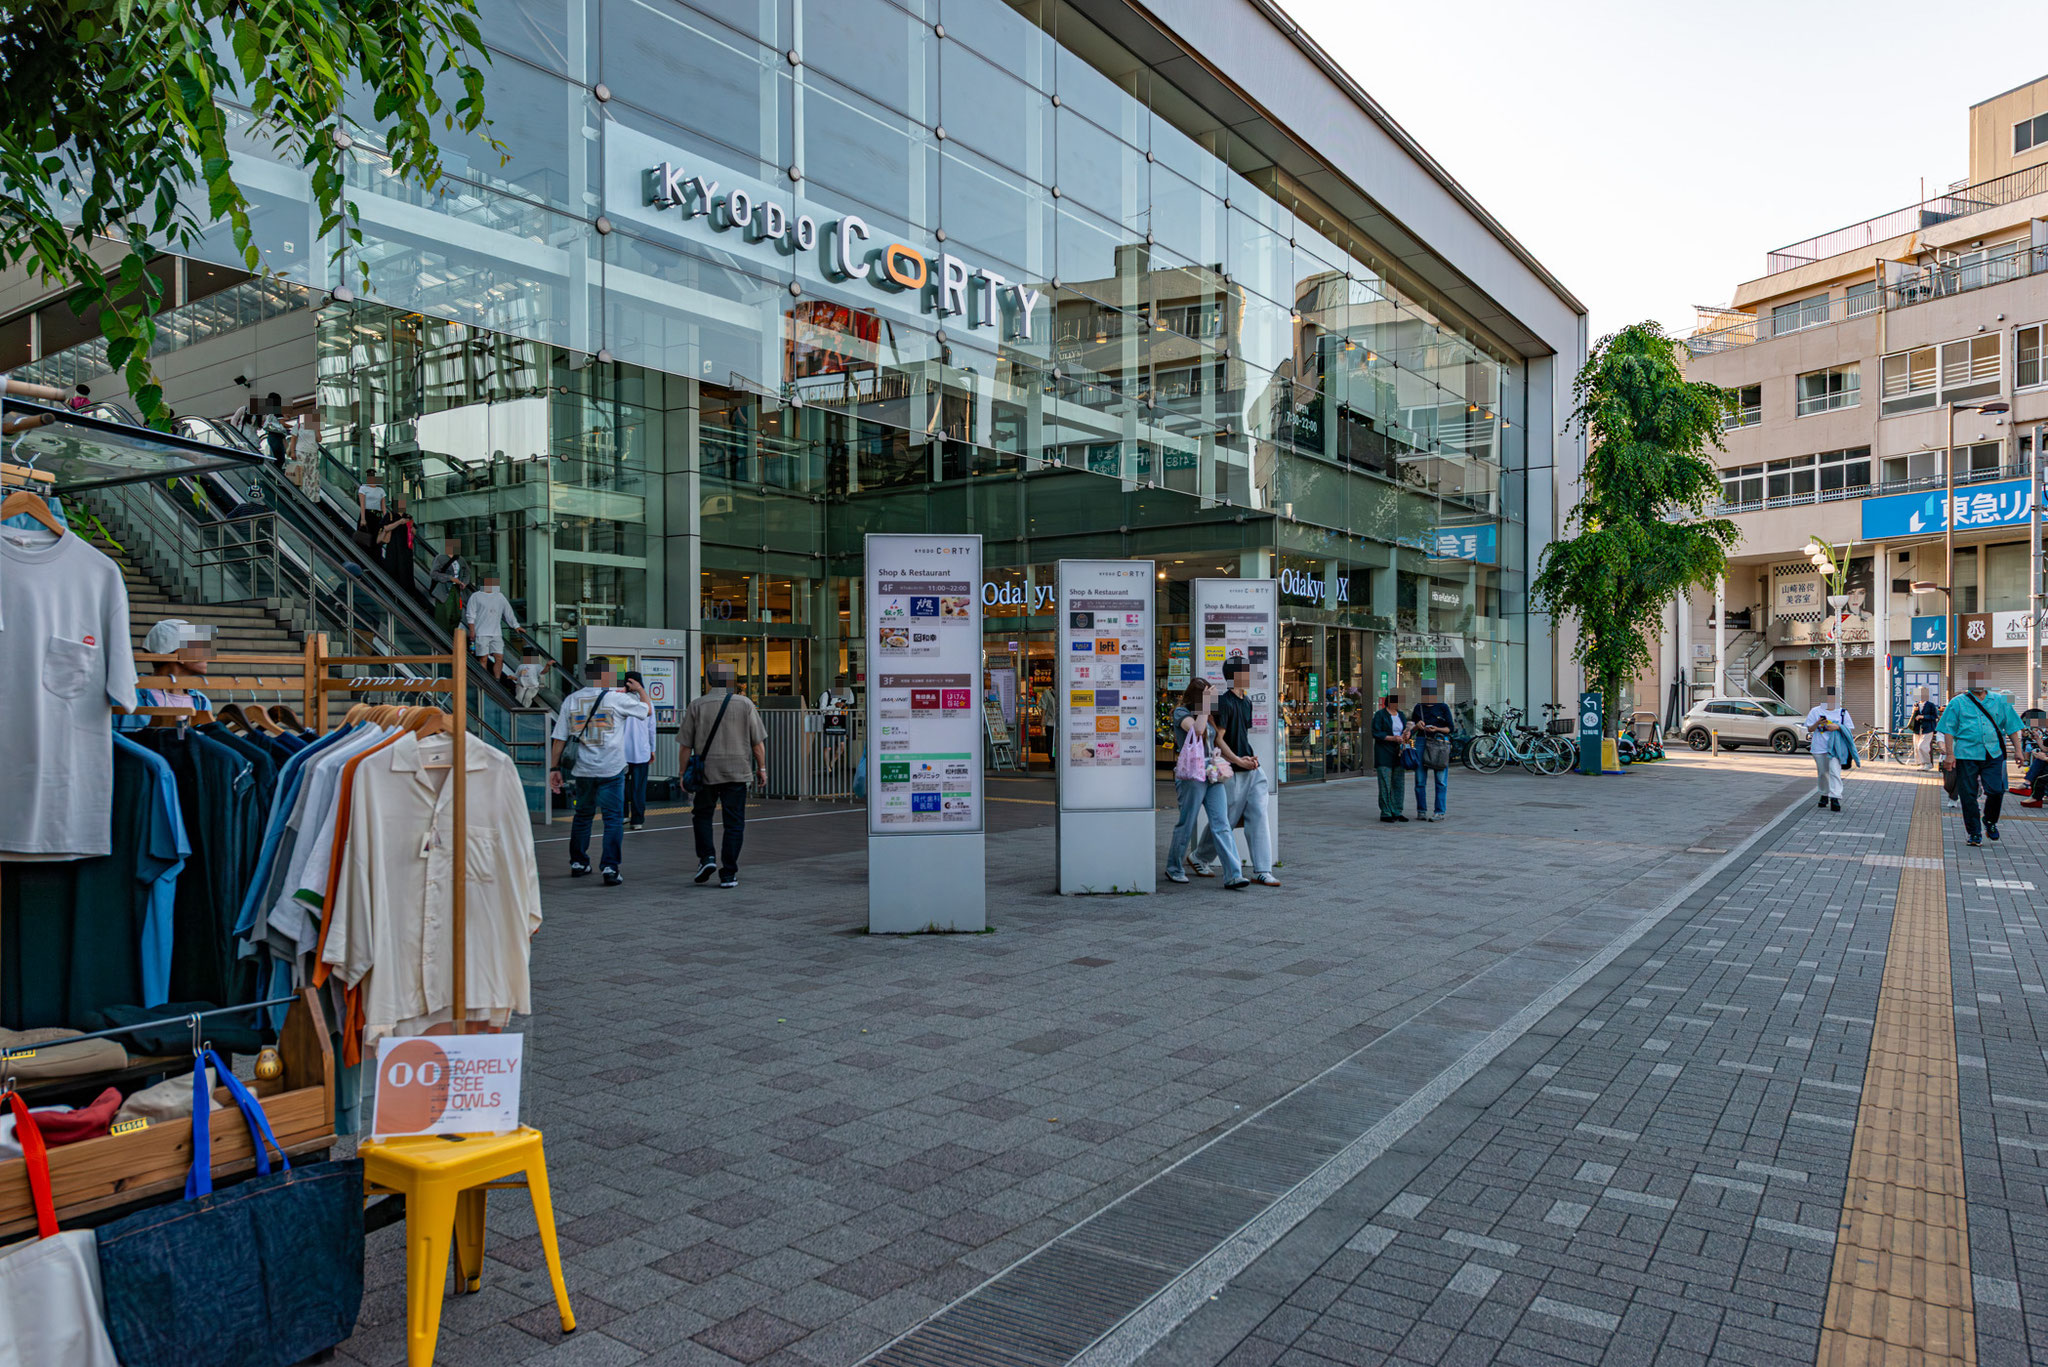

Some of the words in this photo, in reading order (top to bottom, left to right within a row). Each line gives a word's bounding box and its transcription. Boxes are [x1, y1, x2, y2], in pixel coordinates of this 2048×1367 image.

[658, 161, 816, 252] KYODO
[837, 215, 1040, 340] CORTY
[1295, 402, 1309, 416] OPEN
[936, 547, 971, 555] CORTY
[878, 568, 898, 577] Shop
[901, 569, 907, 577] &
[909, 568, 951, 577] Restaurant
[882, 583, 894, 592] 4F
[1069, 588, 1086, 597] Shop
[1072, 601, 1082, 609] 2F
[1204, 603, 1219, 611] Shop
[1099, 641, 1116, 652] Loft
[883, 677, 895, 686] 3F
[454, 1058, 518, 1075] RARELY
[452, 1076, 484, 1092] SEE
[451, 1092, 501, 1109] OWLS
